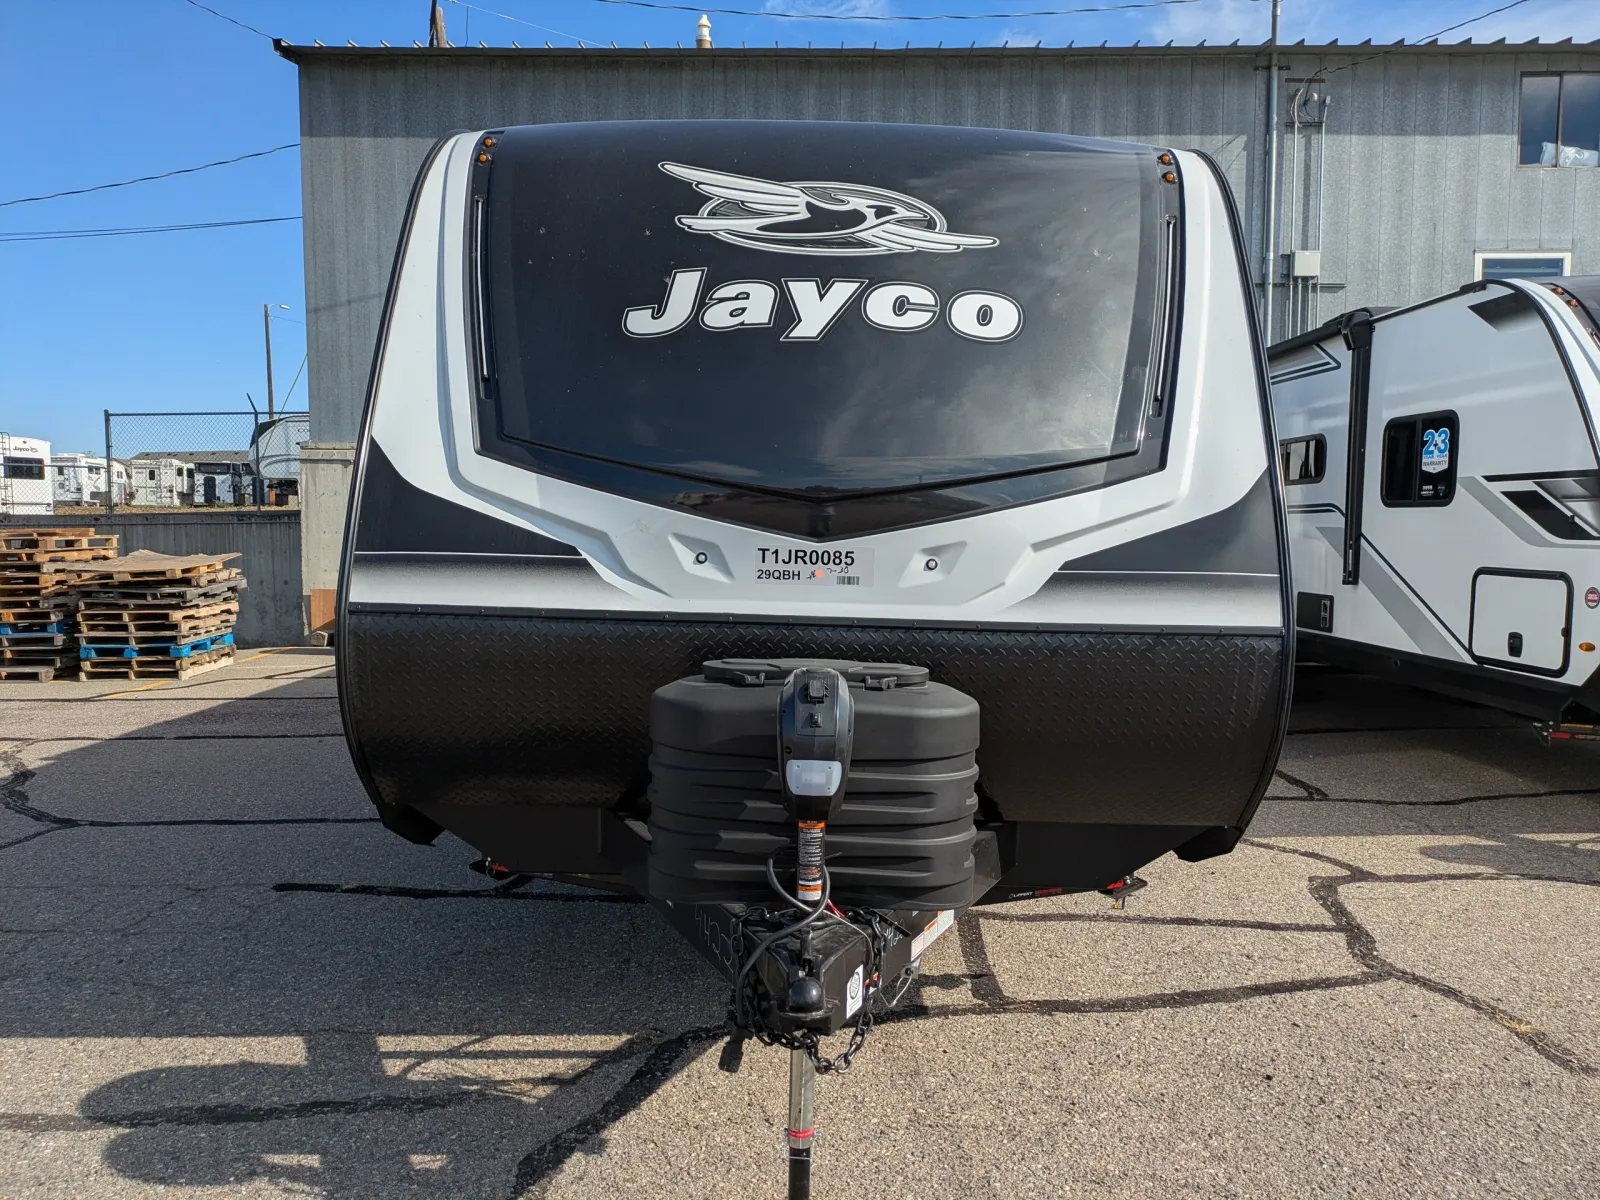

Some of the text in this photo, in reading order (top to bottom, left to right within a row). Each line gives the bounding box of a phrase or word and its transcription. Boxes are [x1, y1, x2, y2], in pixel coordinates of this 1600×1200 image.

[621, 267, 1023, 342] Jayco
[757, 547, 855, 566] T1JR0085
[757, 569, 801, 580] 29QBH
